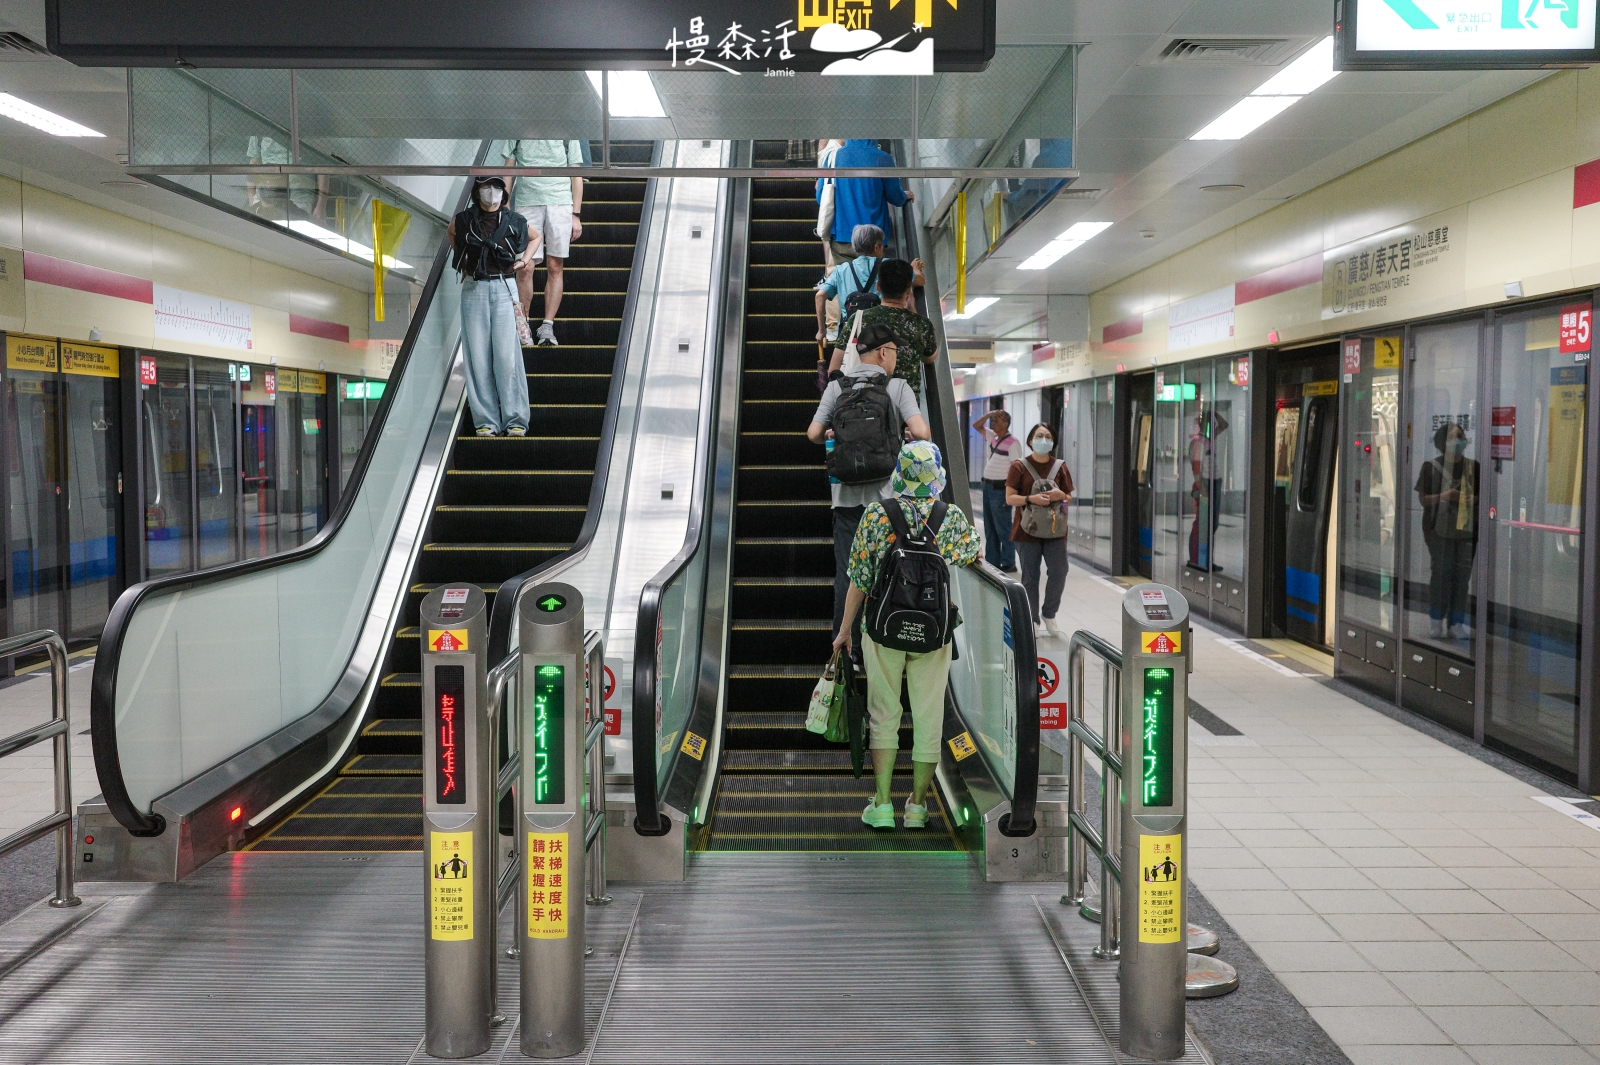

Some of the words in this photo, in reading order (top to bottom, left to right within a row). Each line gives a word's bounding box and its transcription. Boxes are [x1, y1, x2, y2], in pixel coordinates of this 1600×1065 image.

[836, 9, 873, 29] EXIT
[1446, 12, 1492, 23] 緊急出口
[1457, 25, 1479, 33] EXIT
[1348, 239, 1412, 285] 廣慈/奉天宮
[1391, 274, 1410, 289] TEMPLE
[1577, 310, 1589, 343] 5
[1354, 345, 1360, 368] 5
[149, 361, 156, 380] 5
[1244, 362, 1249, 381] 5
[270, 375, 275, 391] 5
[1040, 707, 1060, 718] 攀爬
[441, 840, 460, 848] 注意
[1153, 843, 1172, 851] 注意
[507, 849, 514, 858] 4
[1011, 848, 1019, 858] 3
[532, 838, 545, 922] 請緊握扶手
[548, 839, 563, 922] 扶梯速度快
